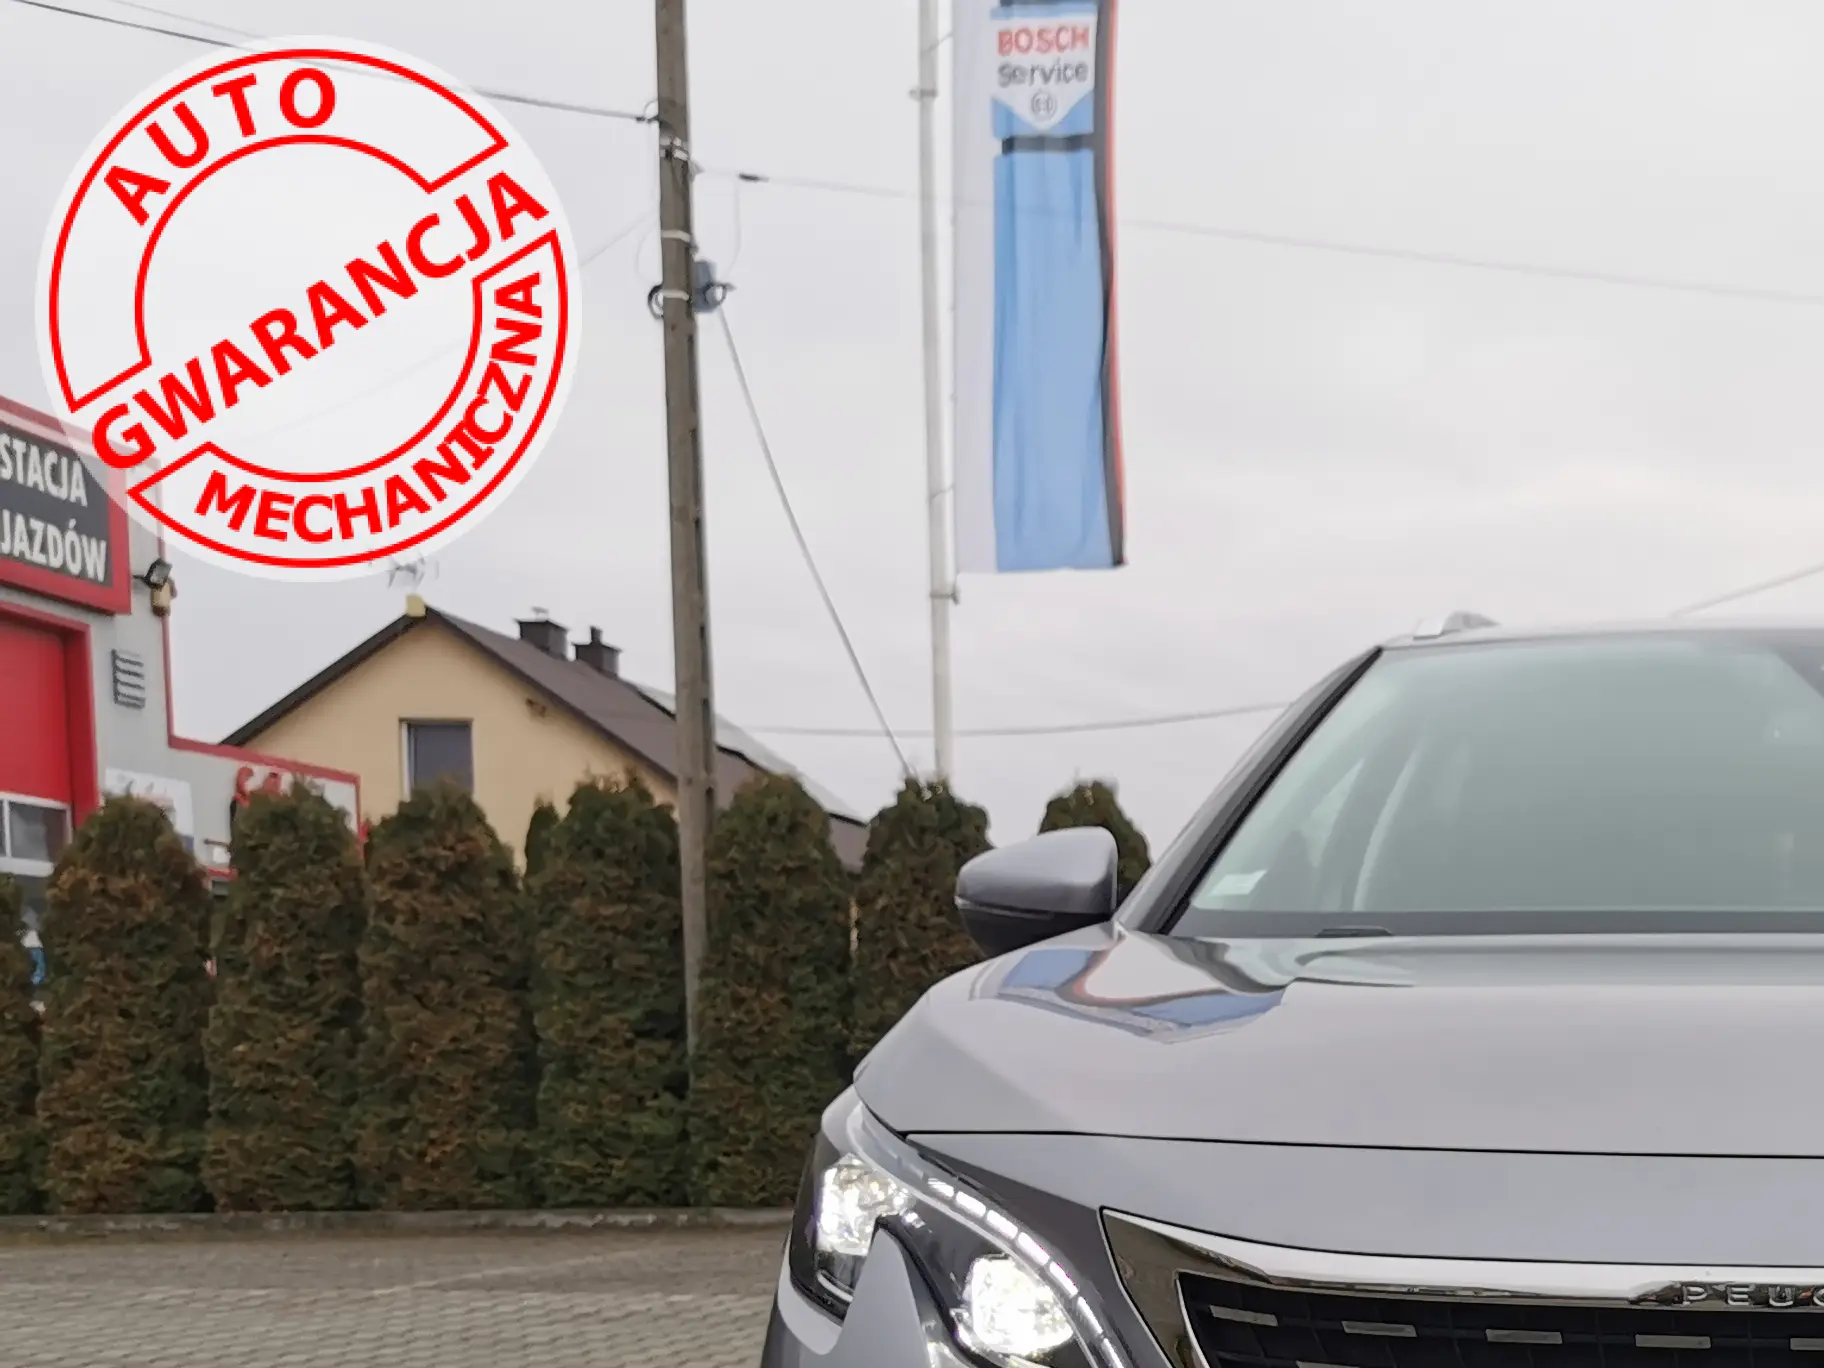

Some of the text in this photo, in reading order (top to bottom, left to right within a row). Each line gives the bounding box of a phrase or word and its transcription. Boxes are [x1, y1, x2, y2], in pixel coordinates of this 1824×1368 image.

[998, 26, 1090, 55] BOSCH
[997, 57, 1089, 87] Service
[0, 433, 88, 508] STACJA
